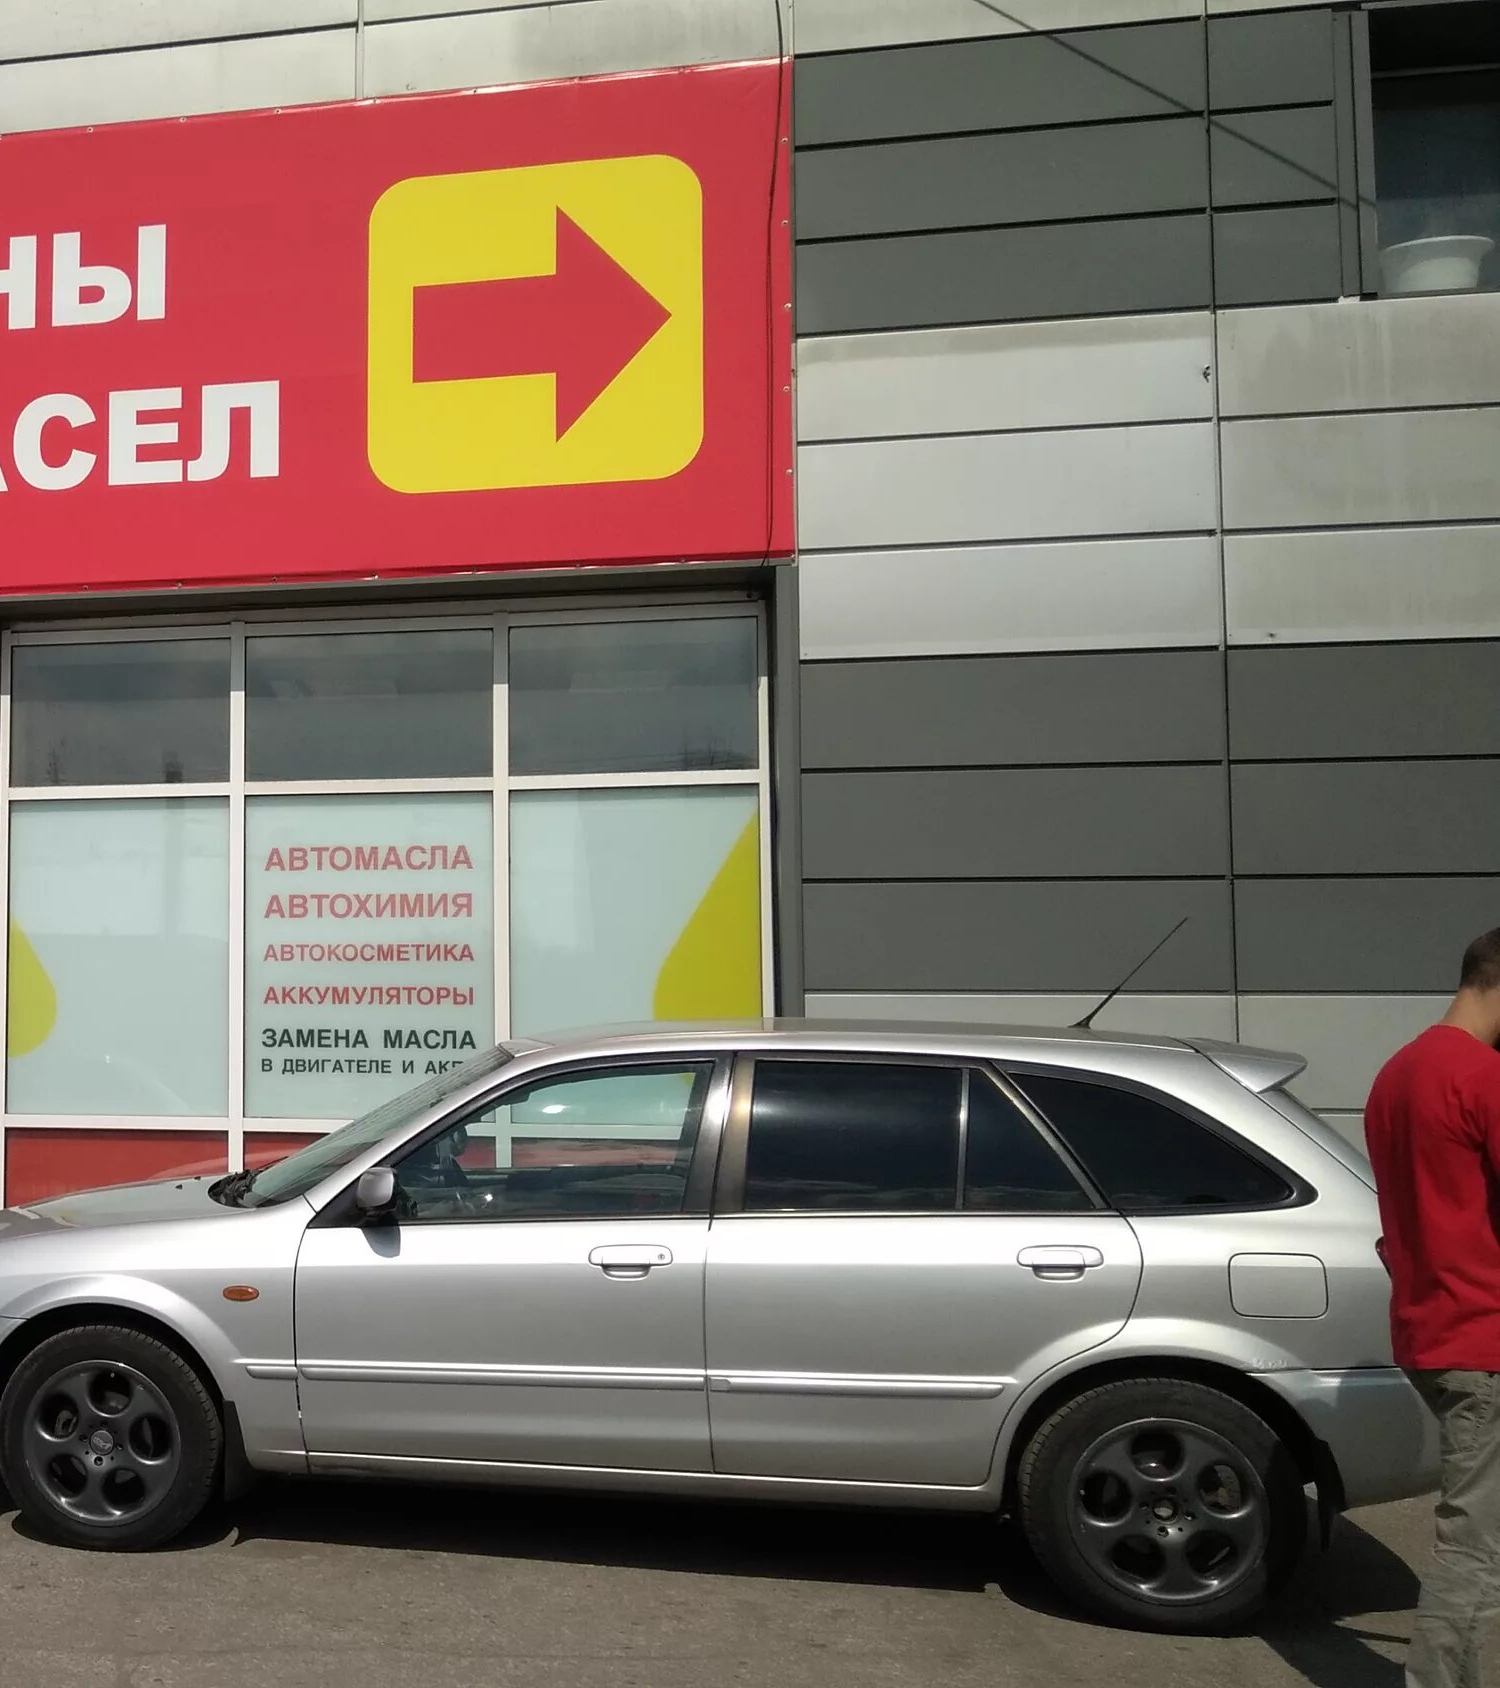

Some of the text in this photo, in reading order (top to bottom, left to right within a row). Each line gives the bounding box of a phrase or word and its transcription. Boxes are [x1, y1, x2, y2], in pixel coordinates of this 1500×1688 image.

[264, 845, 473, 871] АВТОМАСЛА
[264, 893, 473, 919] АВТОХИМИЯ
[264, 944, 474, 962] АВТОКОСМЕТИКА
[263, 987, 474, 1005] АККУМУЛЯТОРЫ
[261, 1029, 477, 1050] ЗАМЕНА МАСЛА
[261, 1059, 273, 1072] В
[282, 1059, 392, 1074] ДВИГАТЕЛЕ
[402, 1060, 414, 1074] И
